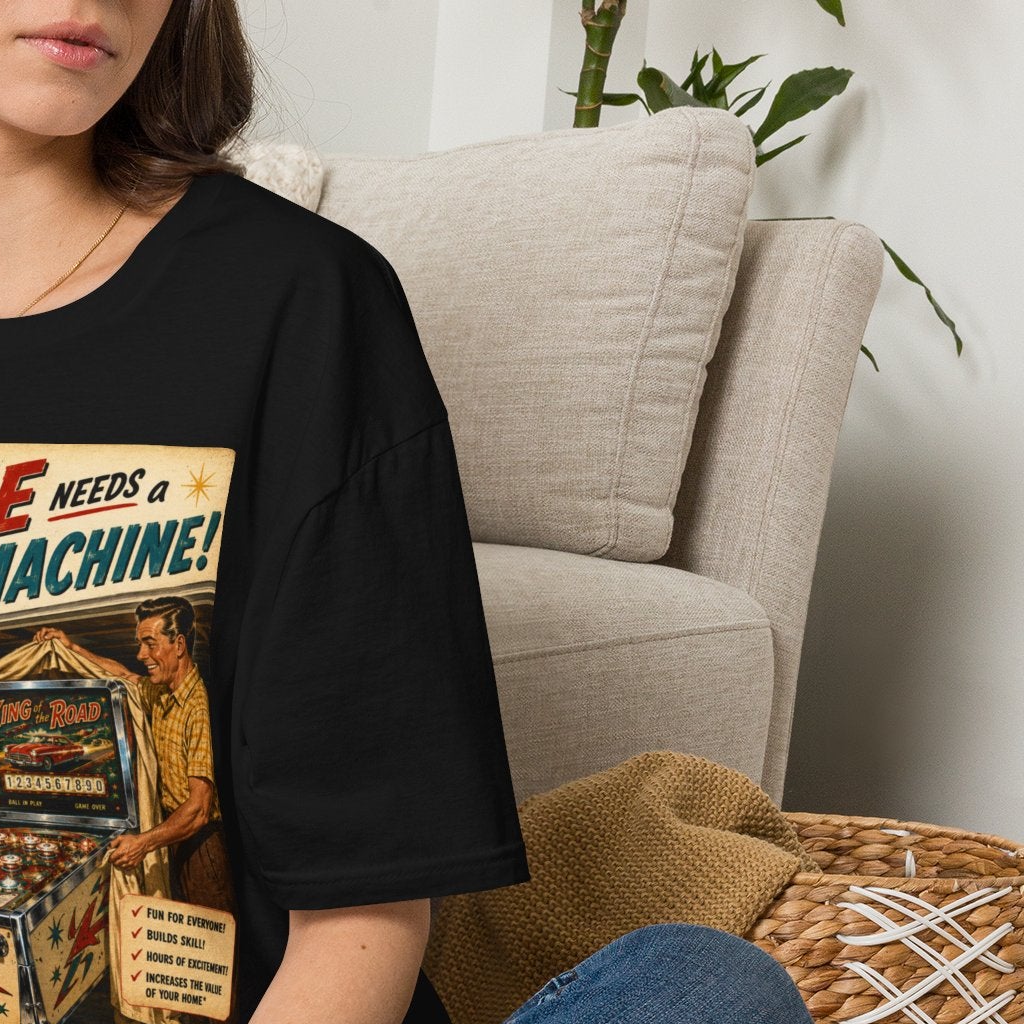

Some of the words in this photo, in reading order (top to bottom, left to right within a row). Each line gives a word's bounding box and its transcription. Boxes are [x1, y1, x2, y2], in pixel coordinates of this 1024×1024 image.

[48, 468, 147, 512] NEEDS
[147, 480, 170, 504] a
[33, 700, 43, 715] of
[49, 699, 102, 730] ROAD
[35, 713, 49, 725] the
[74, 803, 90, 811] GAME
[147, 907, 164, 921] FUN
[167, 911, 184, 925] FOR
[187, 915, 226, 933] EVERYONE!
[146, 929, 178, 944] BUILDS
[180, 936, 206, 950] SKILL!
[146, 951, 174, 965] HOURS
[175, 956, 186, 967] OF
[188, 958, 229, 976] EXCITEMENT!
[145, 972, 188, 989] INCREASES
[190, 979, 204, 992] THE
[204, 982, 222, 996] VALUE
[145, 987, 157, 998] OF
[159, 988, 180, 1002] YOUR
